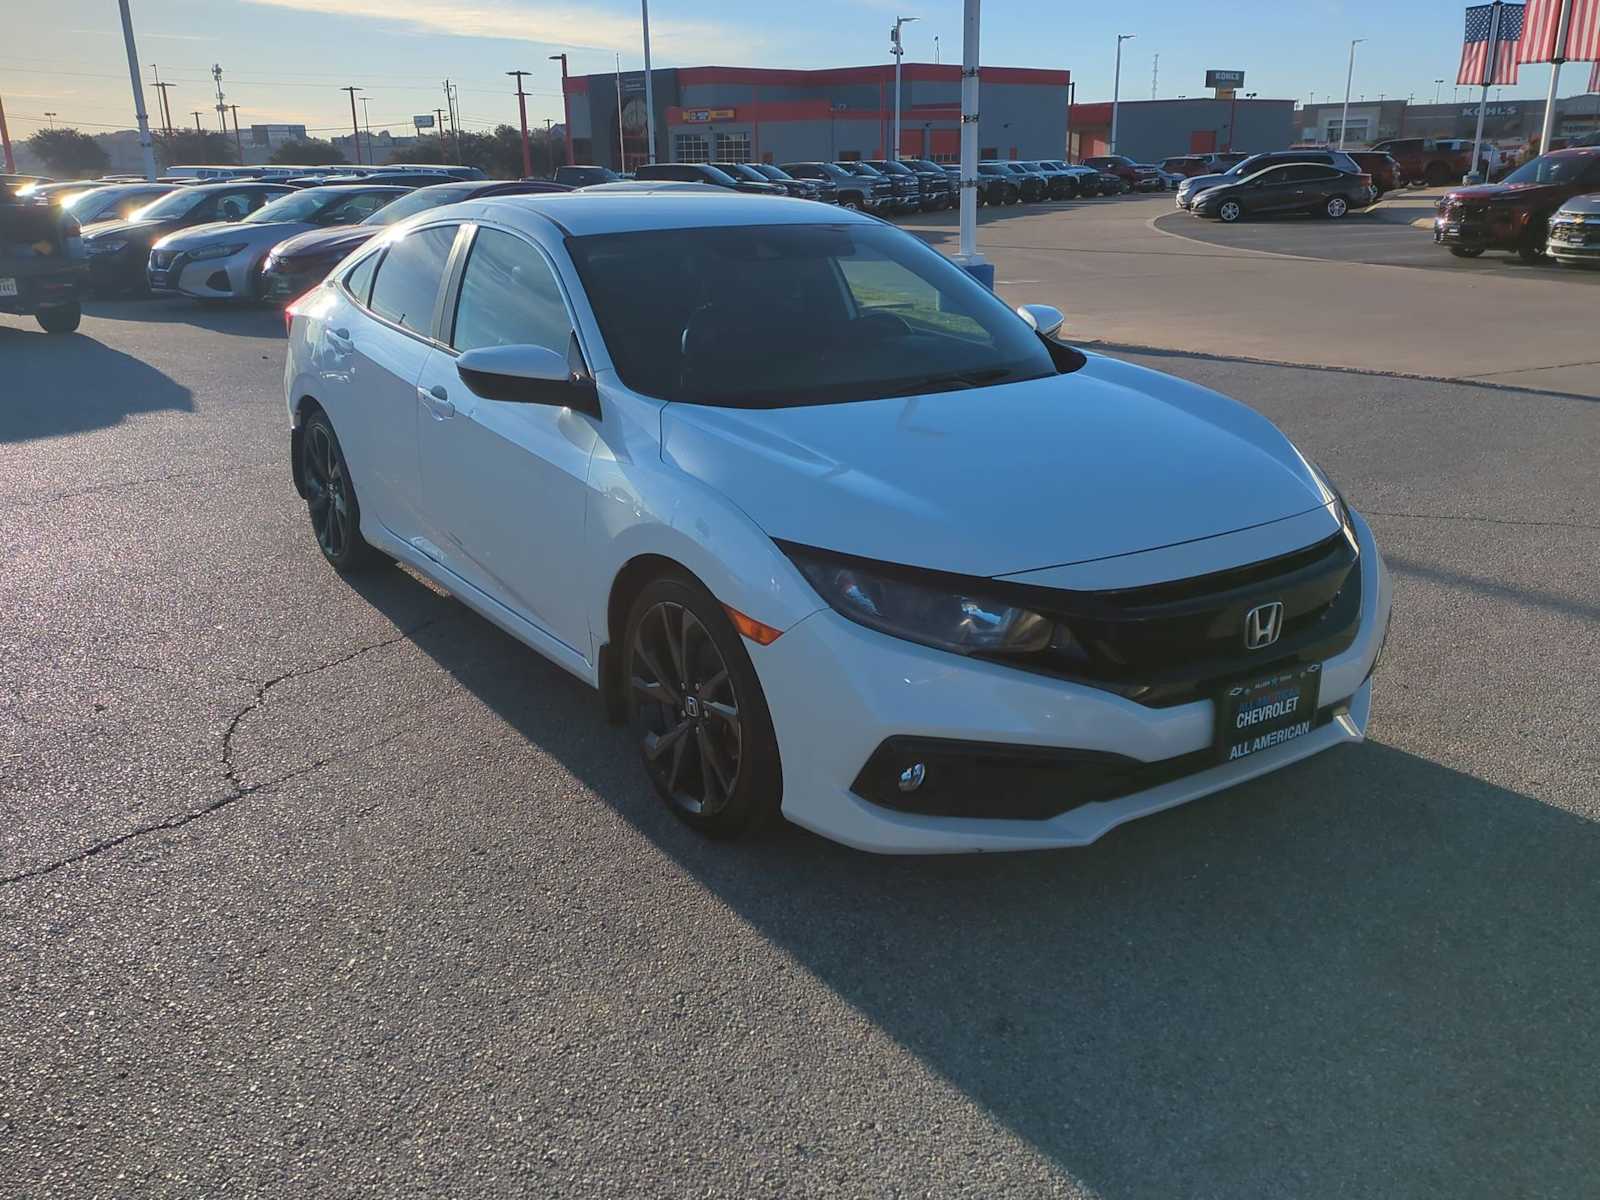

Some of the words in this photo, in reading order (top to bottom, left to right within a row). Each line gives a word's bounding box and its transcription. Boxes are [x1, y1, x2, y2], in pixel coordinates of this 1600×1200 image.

[1236, 696, 1300, 729] CHEVROLET
[1229, 741, 1251, 760] ALL
[1252, 721, 1310, 752] AMERICAN
